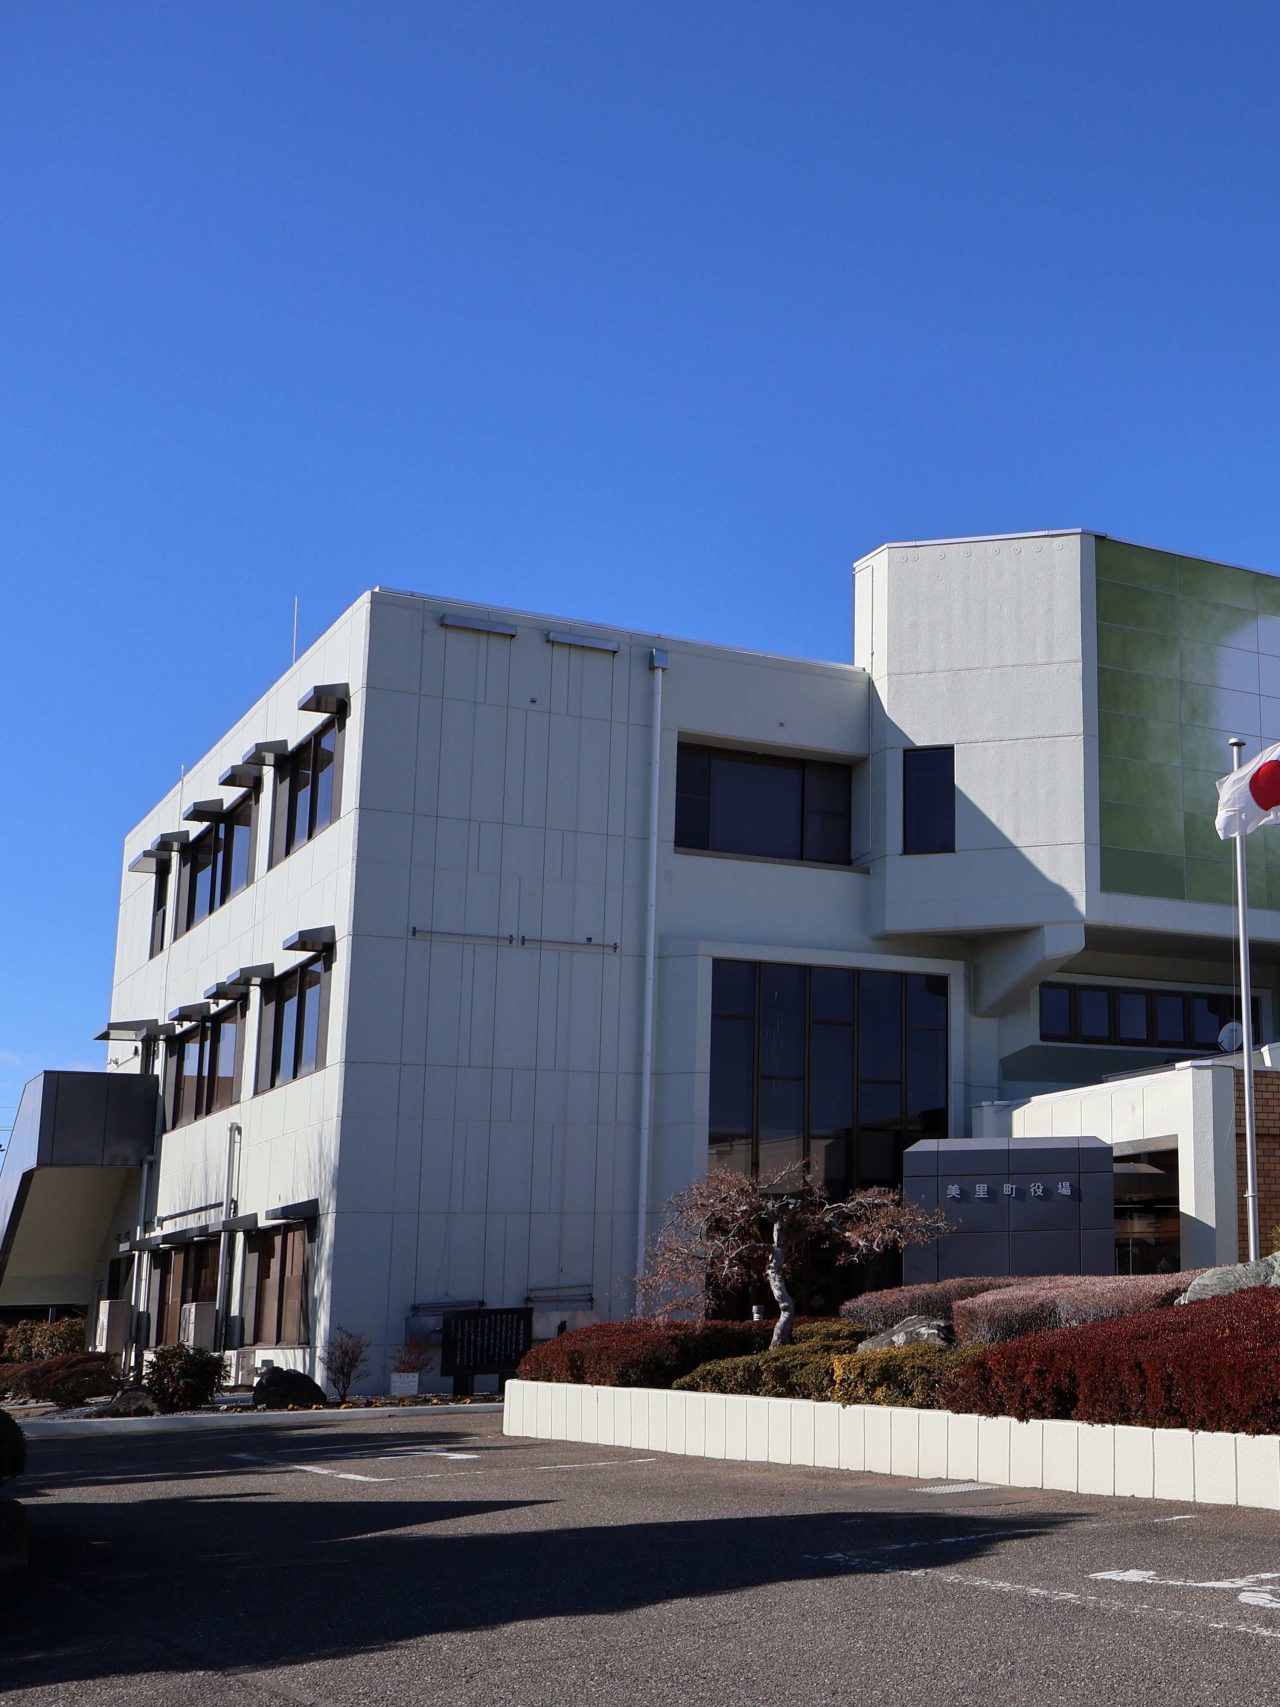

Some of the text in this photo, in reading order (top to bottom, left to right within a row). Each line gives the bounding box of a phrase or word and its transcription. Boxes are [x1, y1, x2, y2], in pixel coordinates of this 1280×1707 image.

[946, 1181, 1072, 1199] 美里町役場
